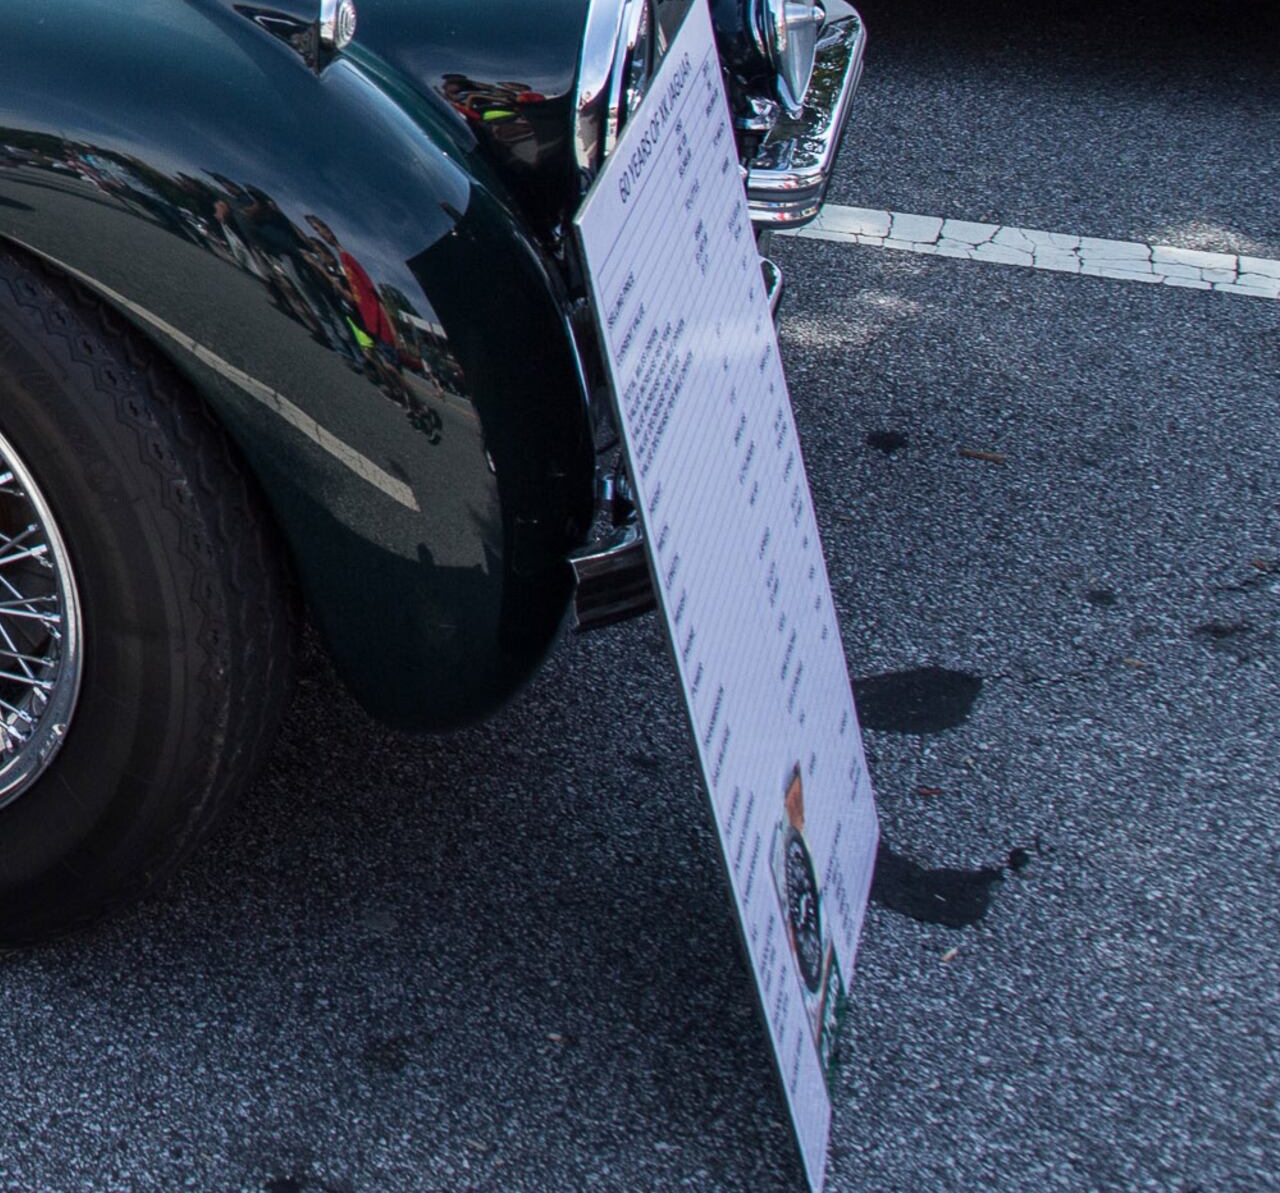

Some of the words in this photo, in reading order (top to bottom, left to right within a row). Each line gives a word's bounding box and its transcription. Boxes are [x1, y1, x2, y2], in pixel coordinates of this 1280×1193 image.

[619, 171, 630, 202] 60
[628, 132, 651, 176] YEARS
[650, 112, 659, 143] OF
[658, 98, 669, 121] XK
[669, 53, 689, 108] JAGUAR
